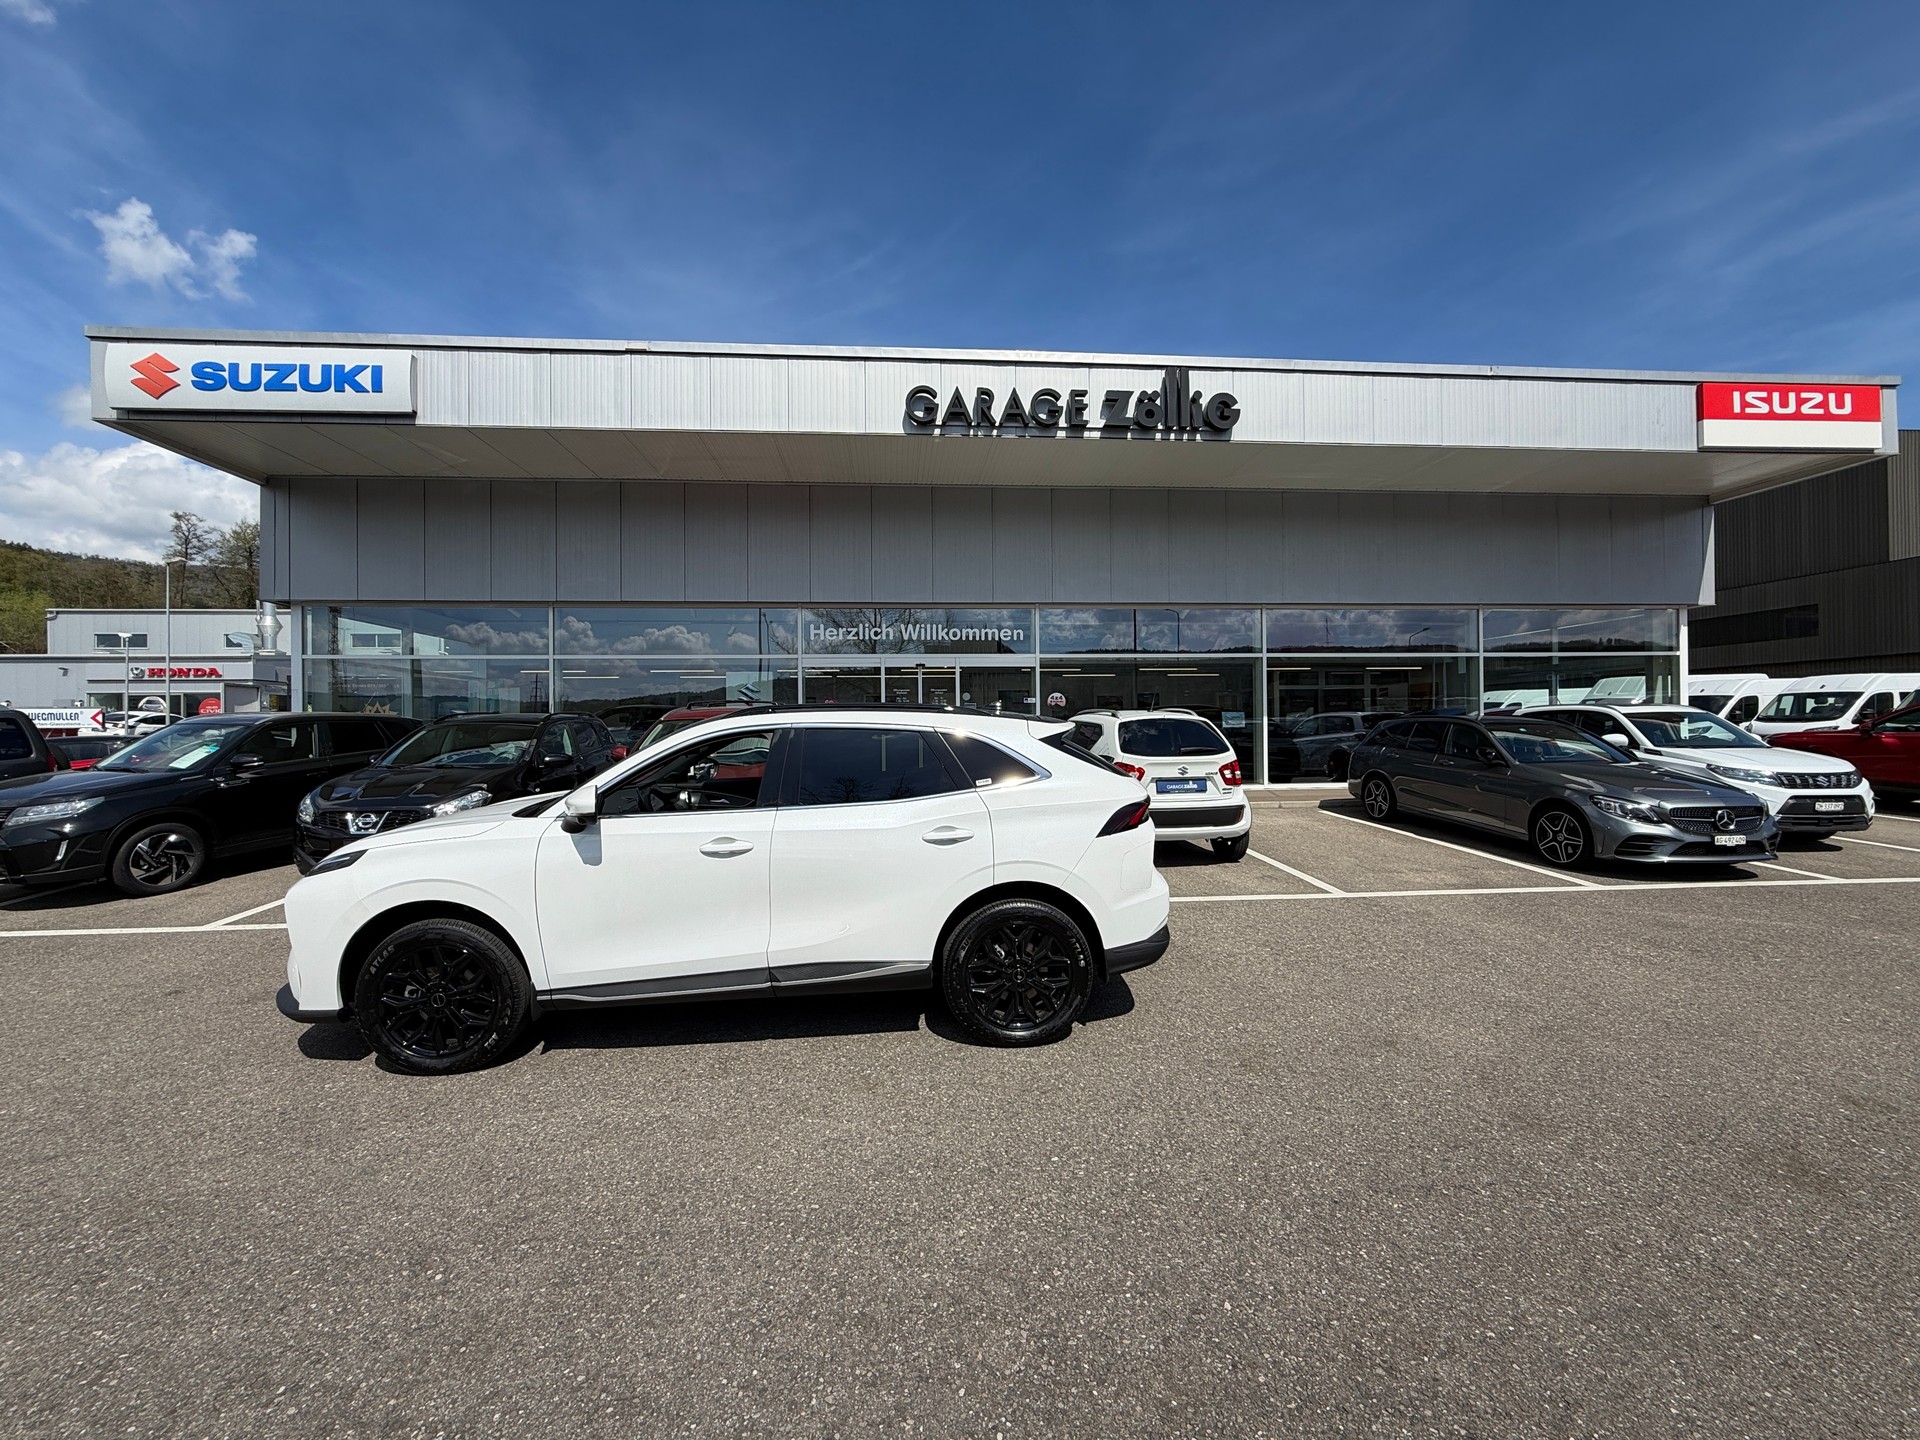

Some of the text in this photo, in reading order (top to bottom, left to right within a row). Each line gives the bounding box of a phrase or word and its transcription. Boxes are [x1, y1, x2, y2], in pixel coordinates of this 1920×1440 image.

[190, 361, 384, 393] SUZUKI
[905, 385, 1090, 428] GARAGE
[1732, 390, 1852, 415] ISUZU
[809, 624, 1024, 641] Herzlich Willkommen
[147, 667, 222, 678] HONDA
[369, 944, 396, 975] ATLAS
